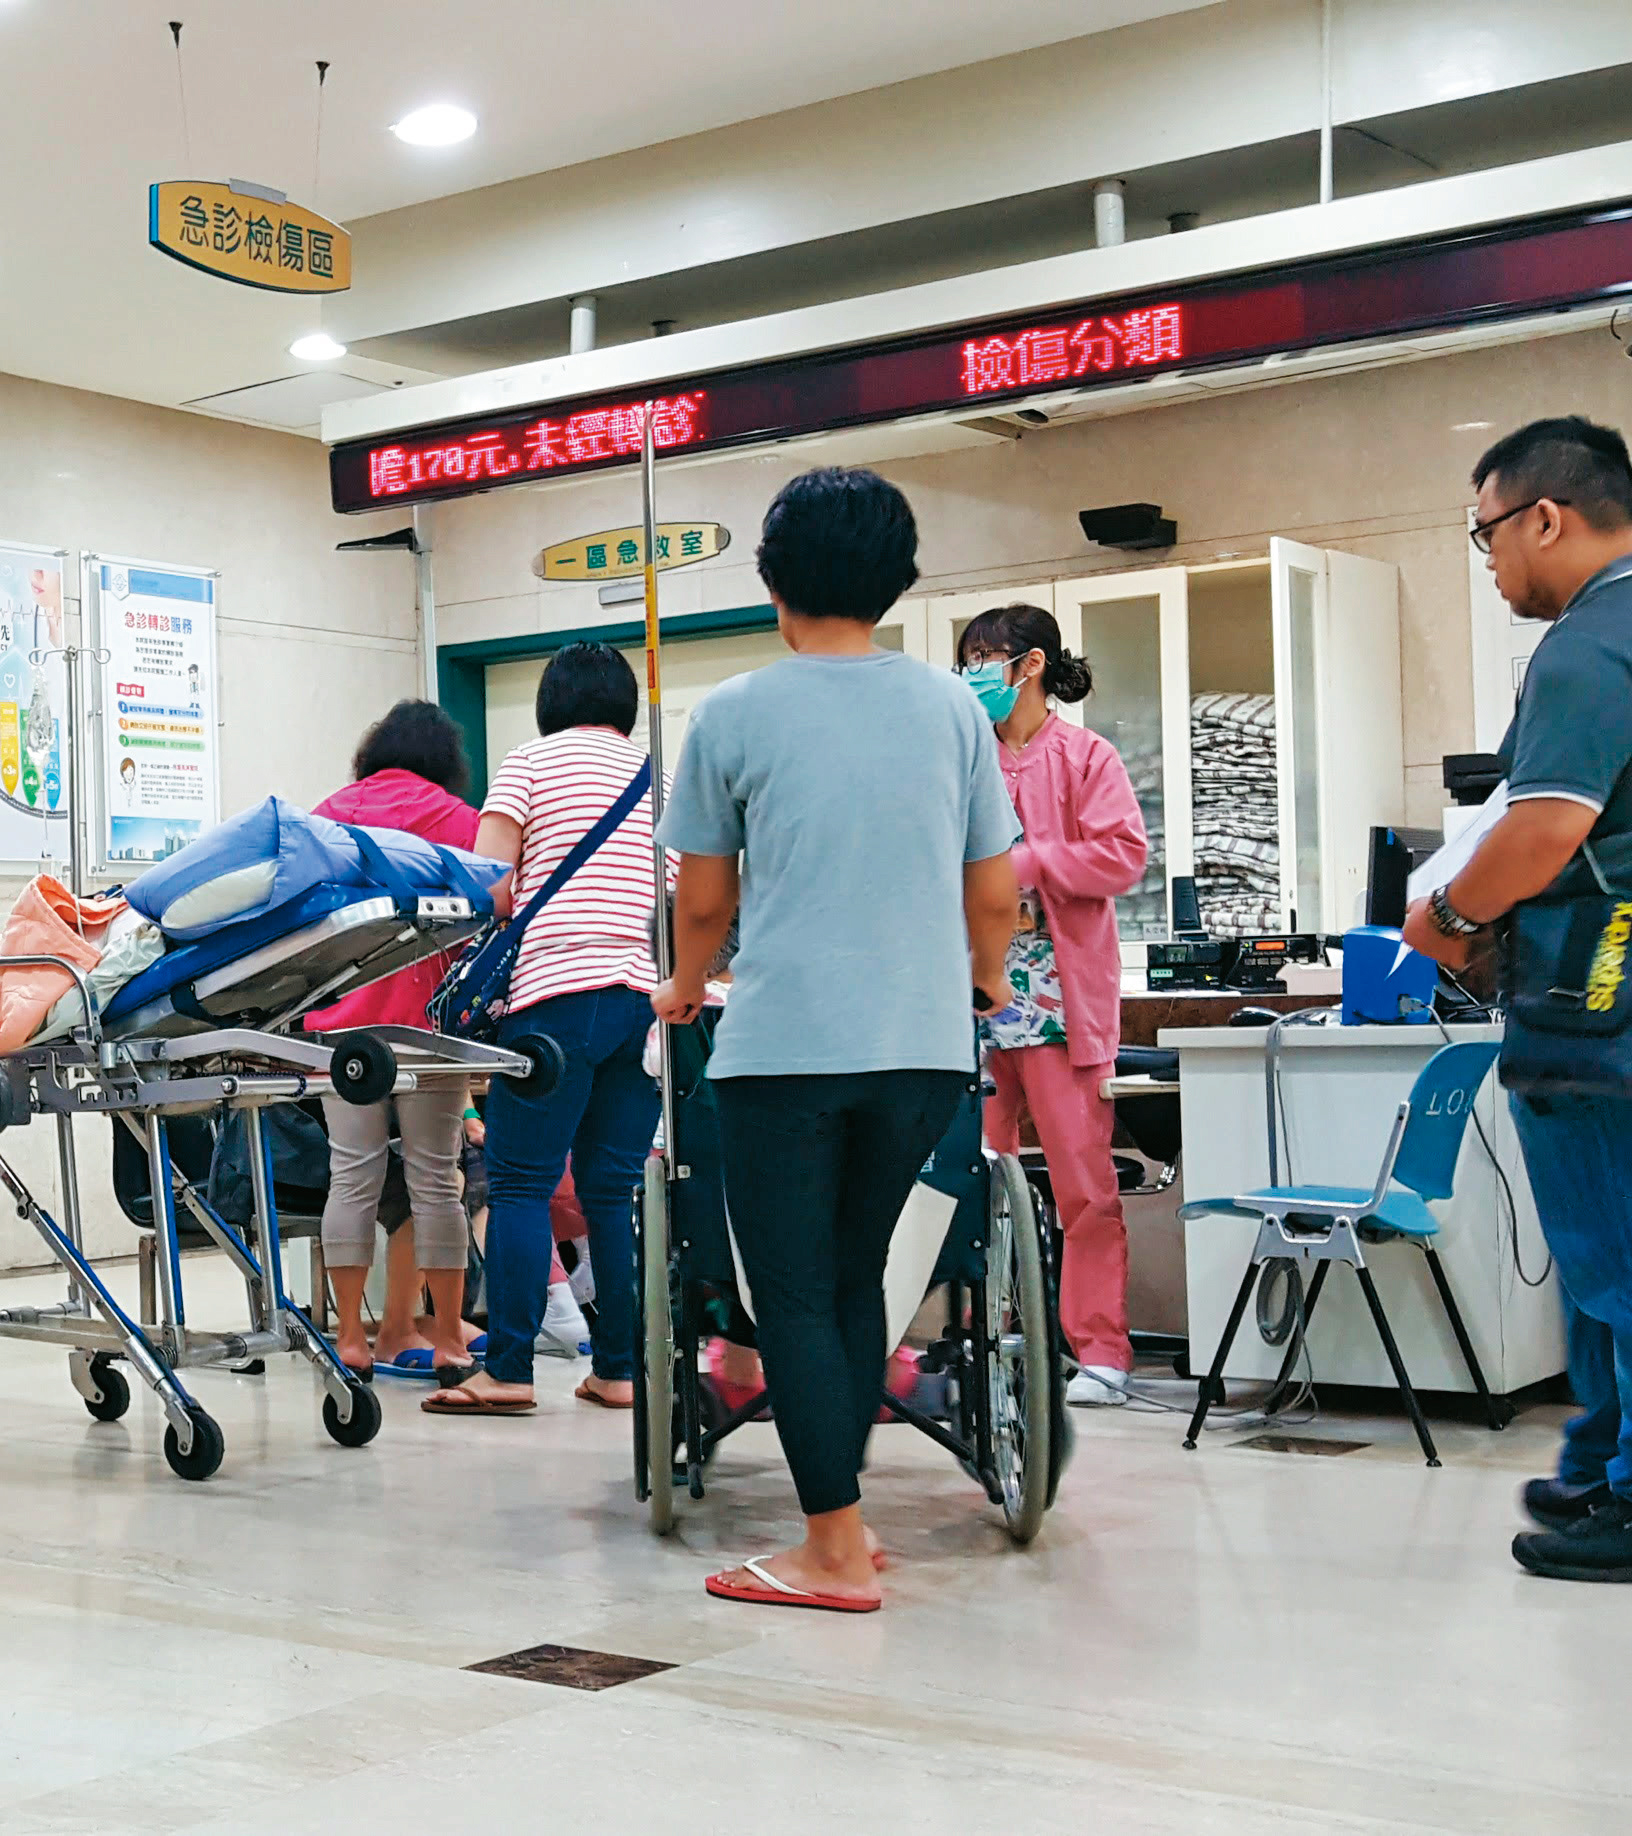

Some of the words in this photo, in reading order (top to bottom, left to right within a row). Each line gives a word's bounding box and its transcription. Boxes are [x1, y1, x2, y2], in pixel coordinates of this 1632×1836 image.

[179, 195, 334, 279] 急診檢傷區
[960, 305, 1184, 392] 檢傷分類
[124, 611, 192, 634] 急診轉診服務
